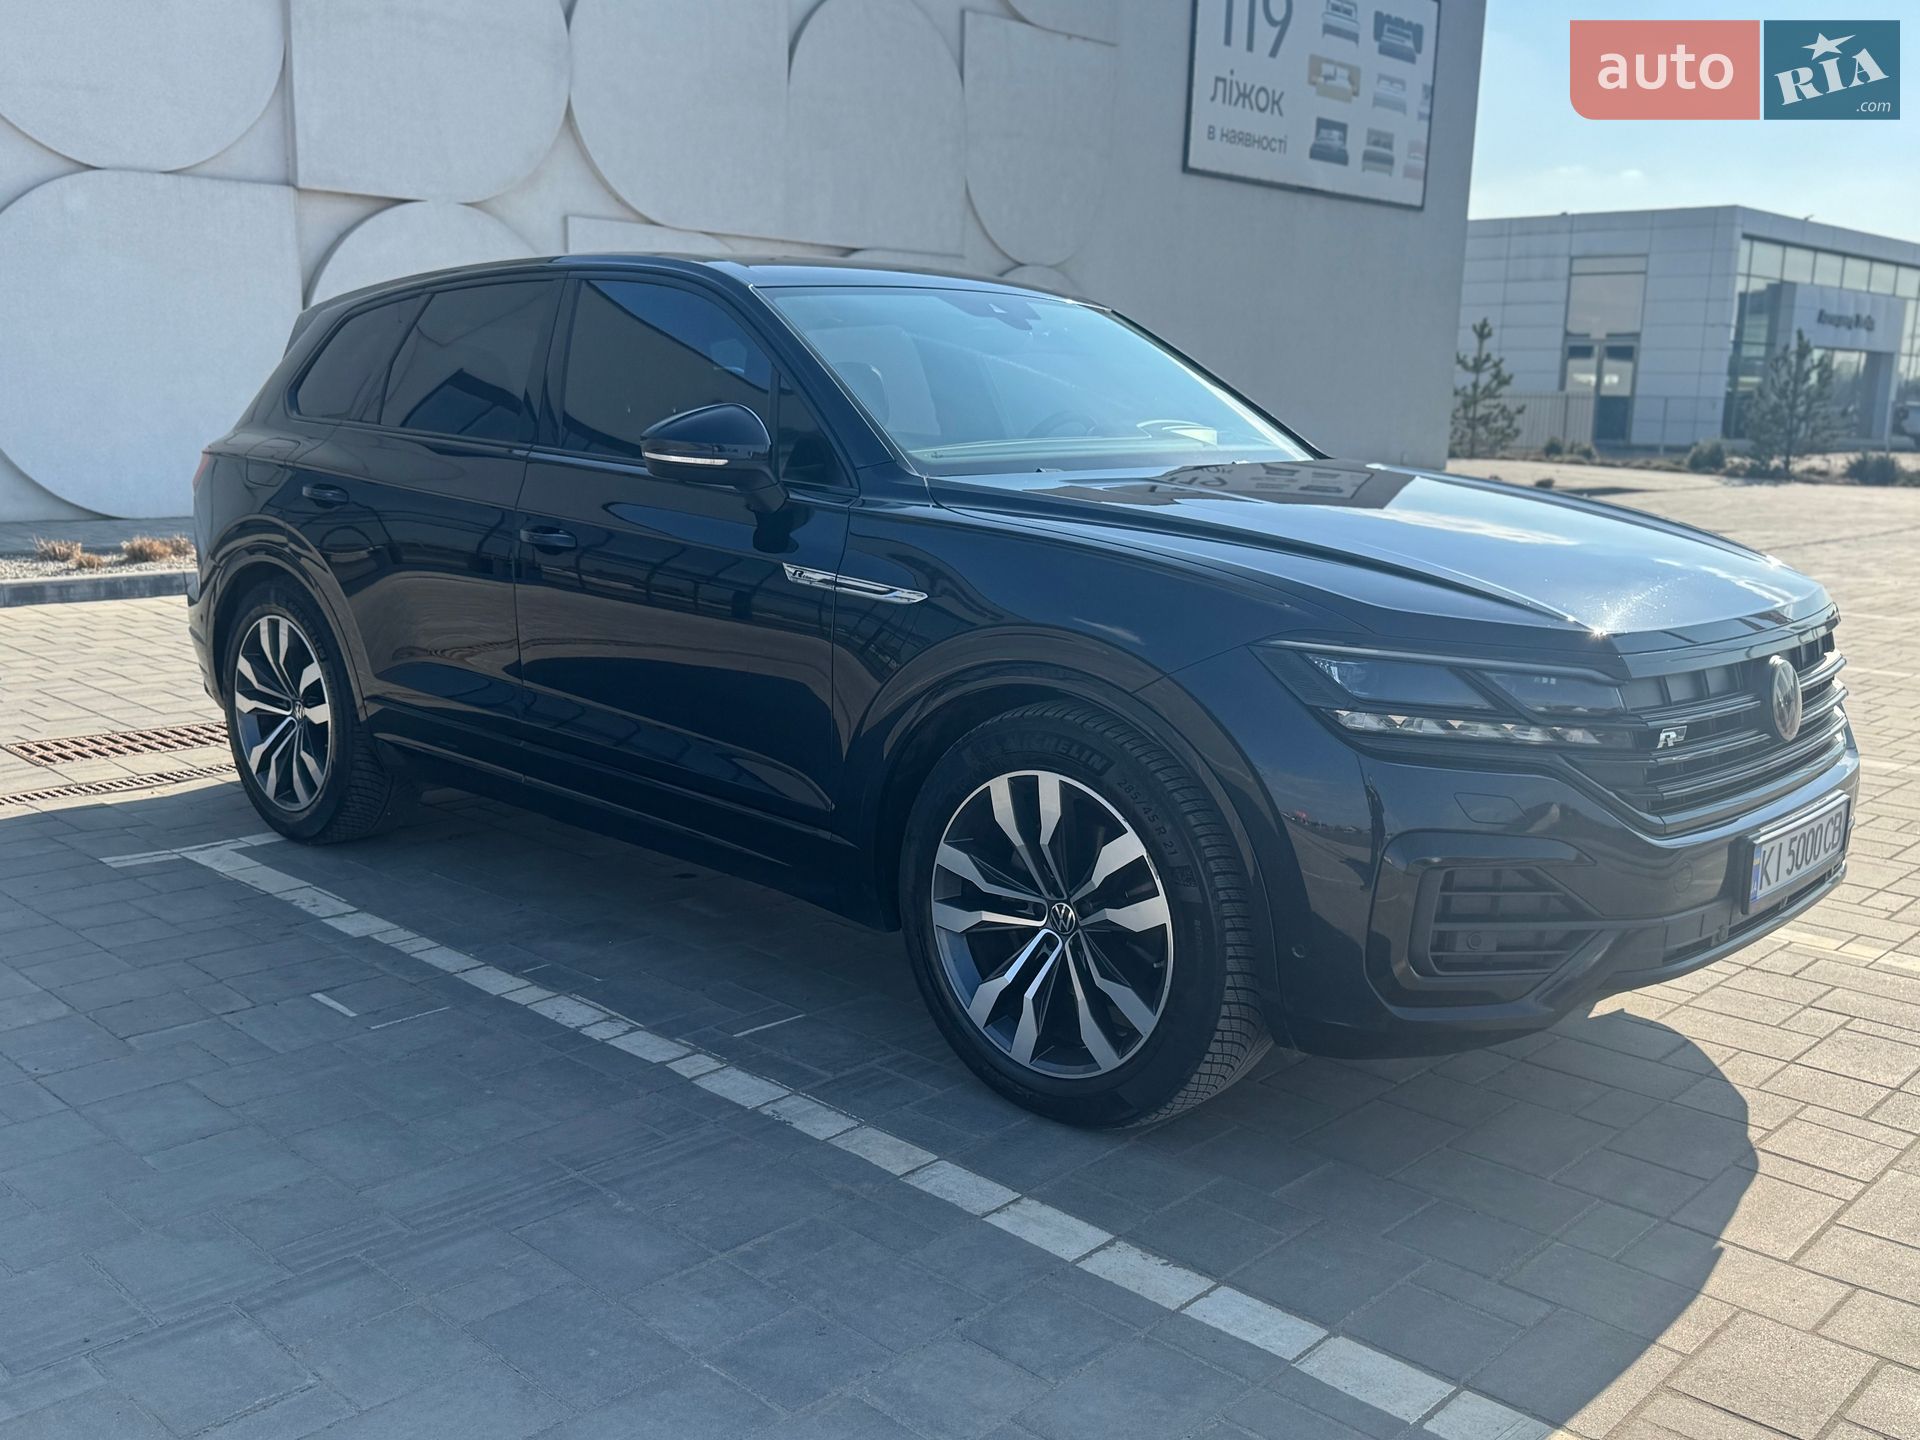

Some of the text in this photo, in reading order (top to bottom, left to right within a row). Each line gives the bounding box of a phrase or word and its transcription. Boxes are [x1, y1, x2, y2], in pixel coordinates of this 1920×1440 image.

[1210, 69, 1285, 118] ліжок
[1207, 125, 1288, 155] в наявності
[1162, 840, 1179, 856] 21
